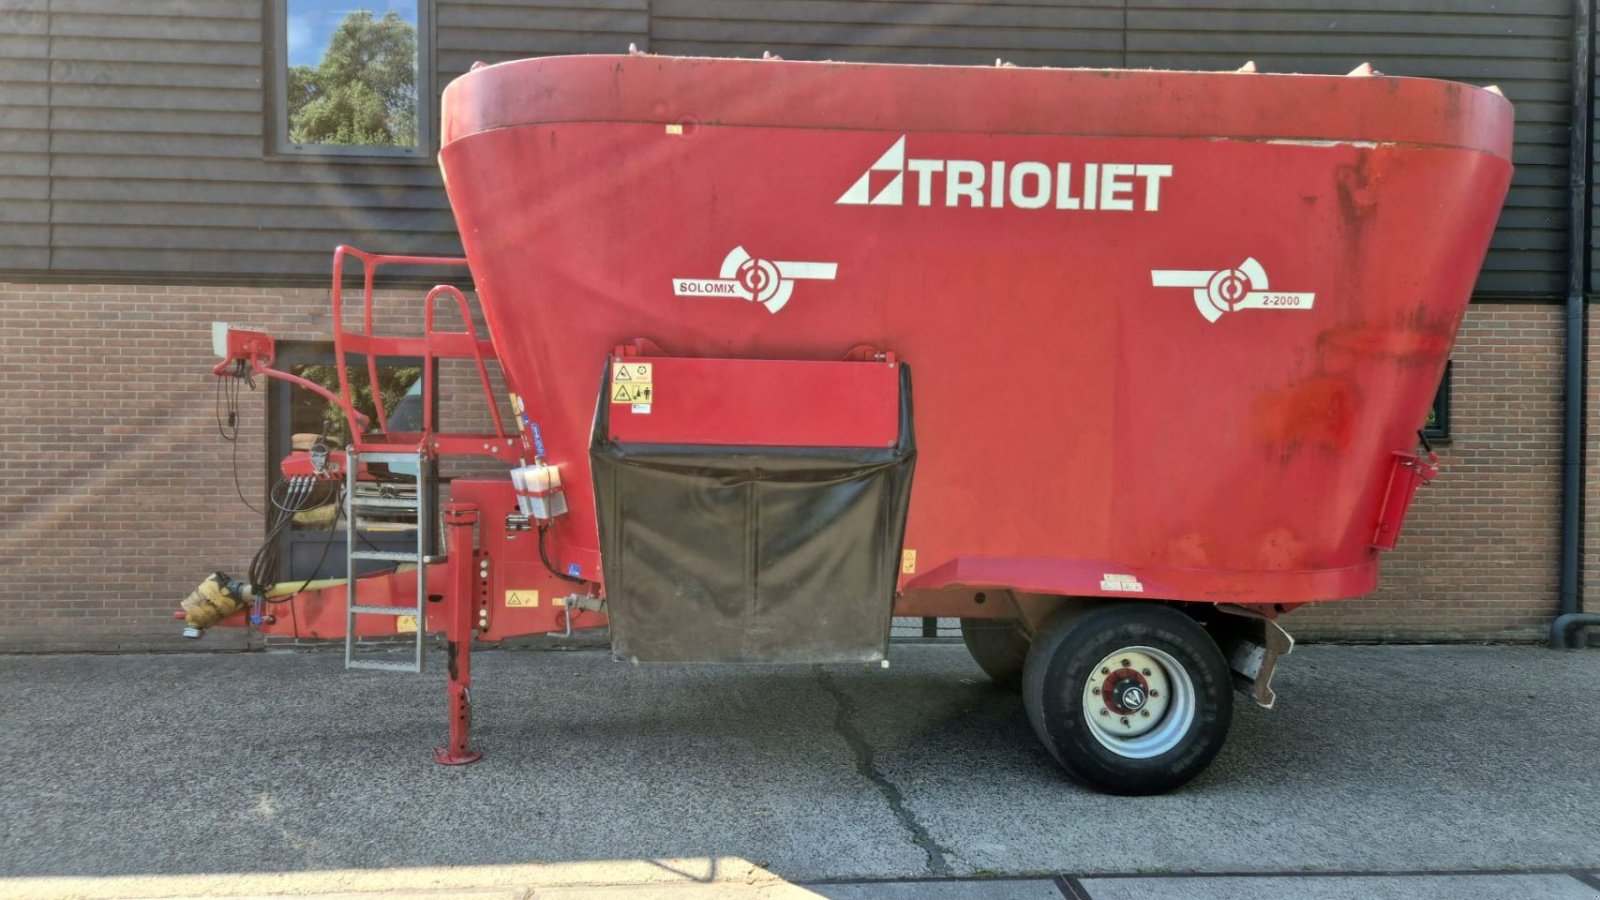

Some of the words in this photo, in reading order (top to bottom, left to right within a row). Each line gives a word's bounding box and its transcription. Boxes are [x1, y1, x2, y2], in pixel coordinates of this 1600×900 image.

[908, 159, 1173, 211] TRIOLIET
[679, 282, 736, 293] SOLOMIX
[1262, 296, 1300, 306] 2-2000
